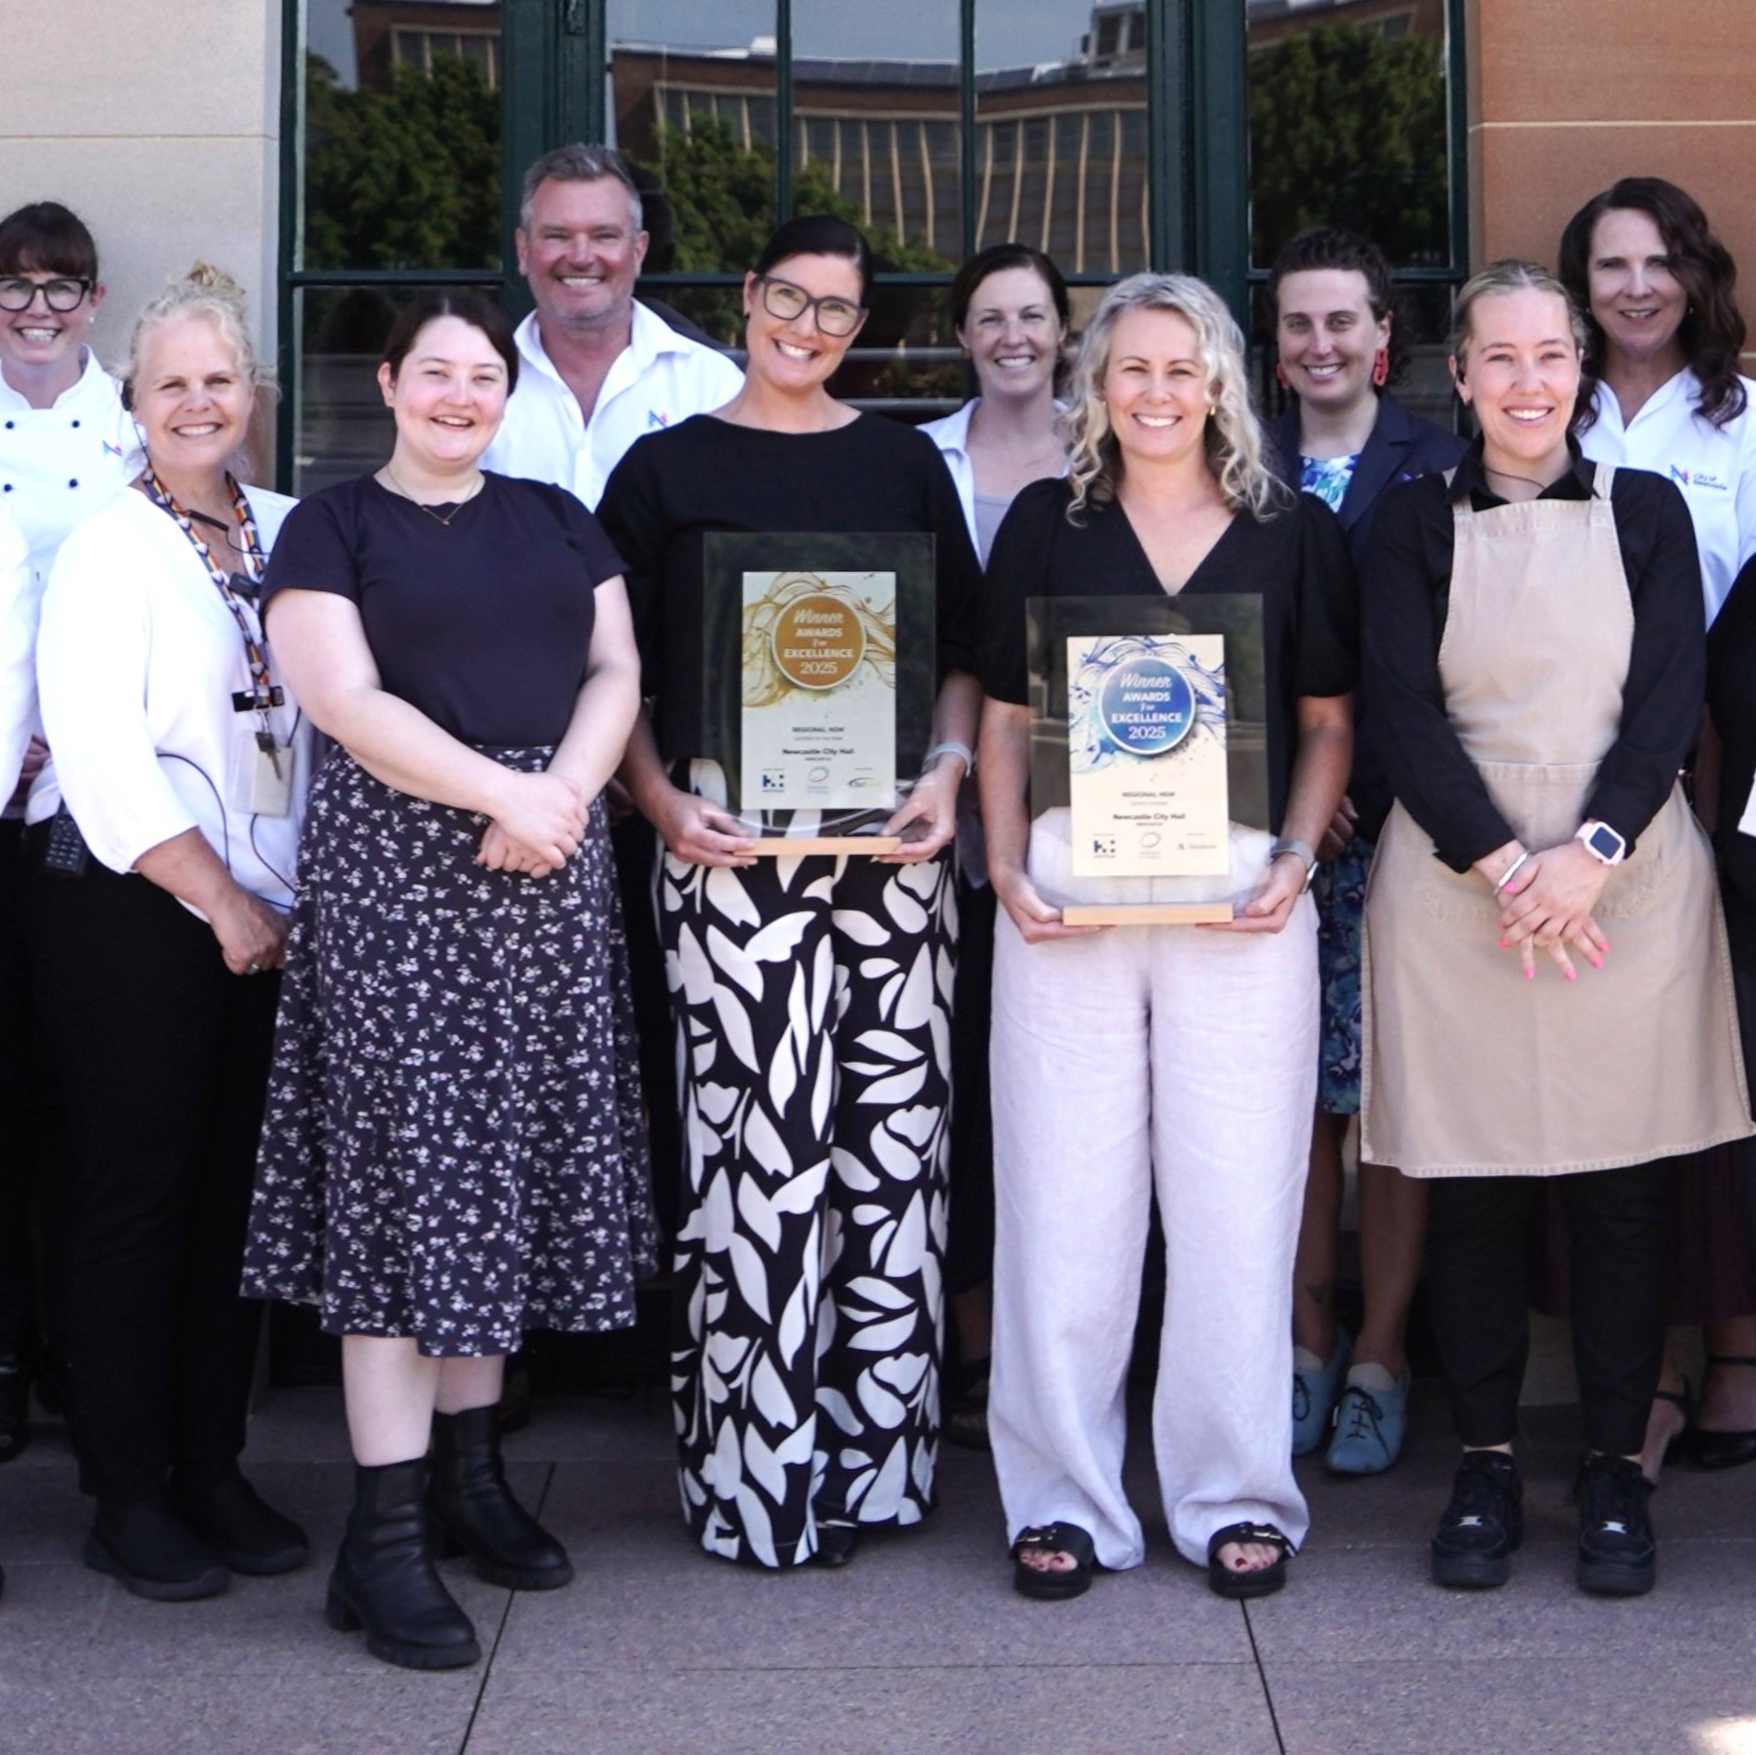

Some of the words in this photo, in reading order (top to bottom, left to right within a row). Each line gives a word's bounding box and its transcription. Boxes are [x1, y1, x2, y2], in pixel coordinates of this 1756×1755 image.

[793, 608, 844, 624] Winner
[795, 627, 843, 638] AWARDS
[784, 648, 853, 658] EXCELLENCE
[800, 661, 837, 674] 2025
[1120, 673, 1173, 689] Winner
[1122, 691, 1171, 702] AWARDS
[1111, 712, 1183, 724] EXCELLENCE
[1128, 726, 1166, 740] 2025
[822, 748, 837, 756] City
[1153, 813, 1168, 821] City
